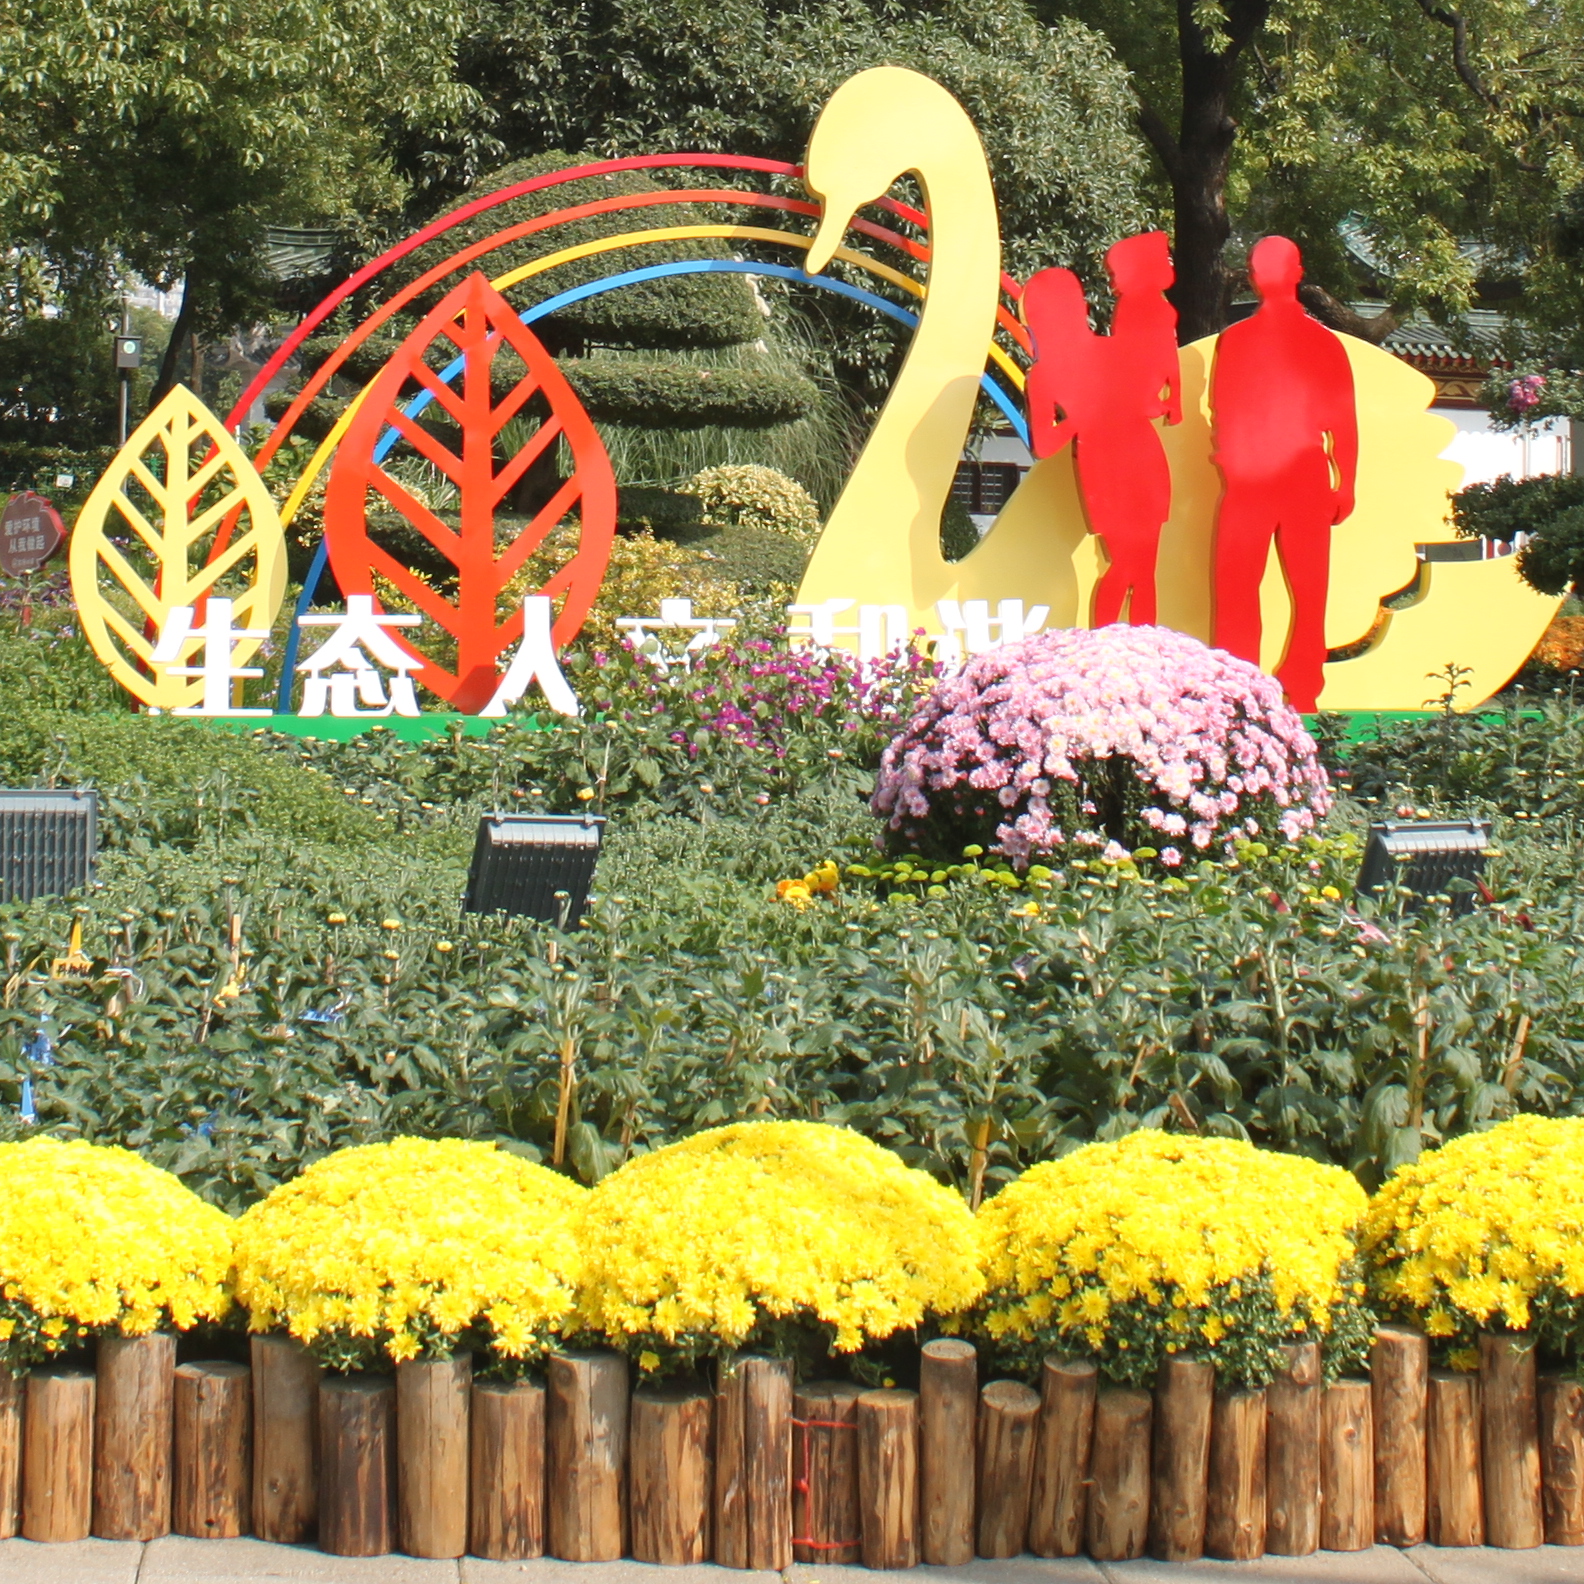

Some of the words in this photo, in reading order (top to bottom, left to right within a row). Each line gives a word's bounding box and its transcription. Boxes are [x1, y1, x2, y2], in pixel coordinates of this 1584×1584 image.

[4, 517, 40, 536] 爱护环境
[8, 535, 45, 554] 从我做起
